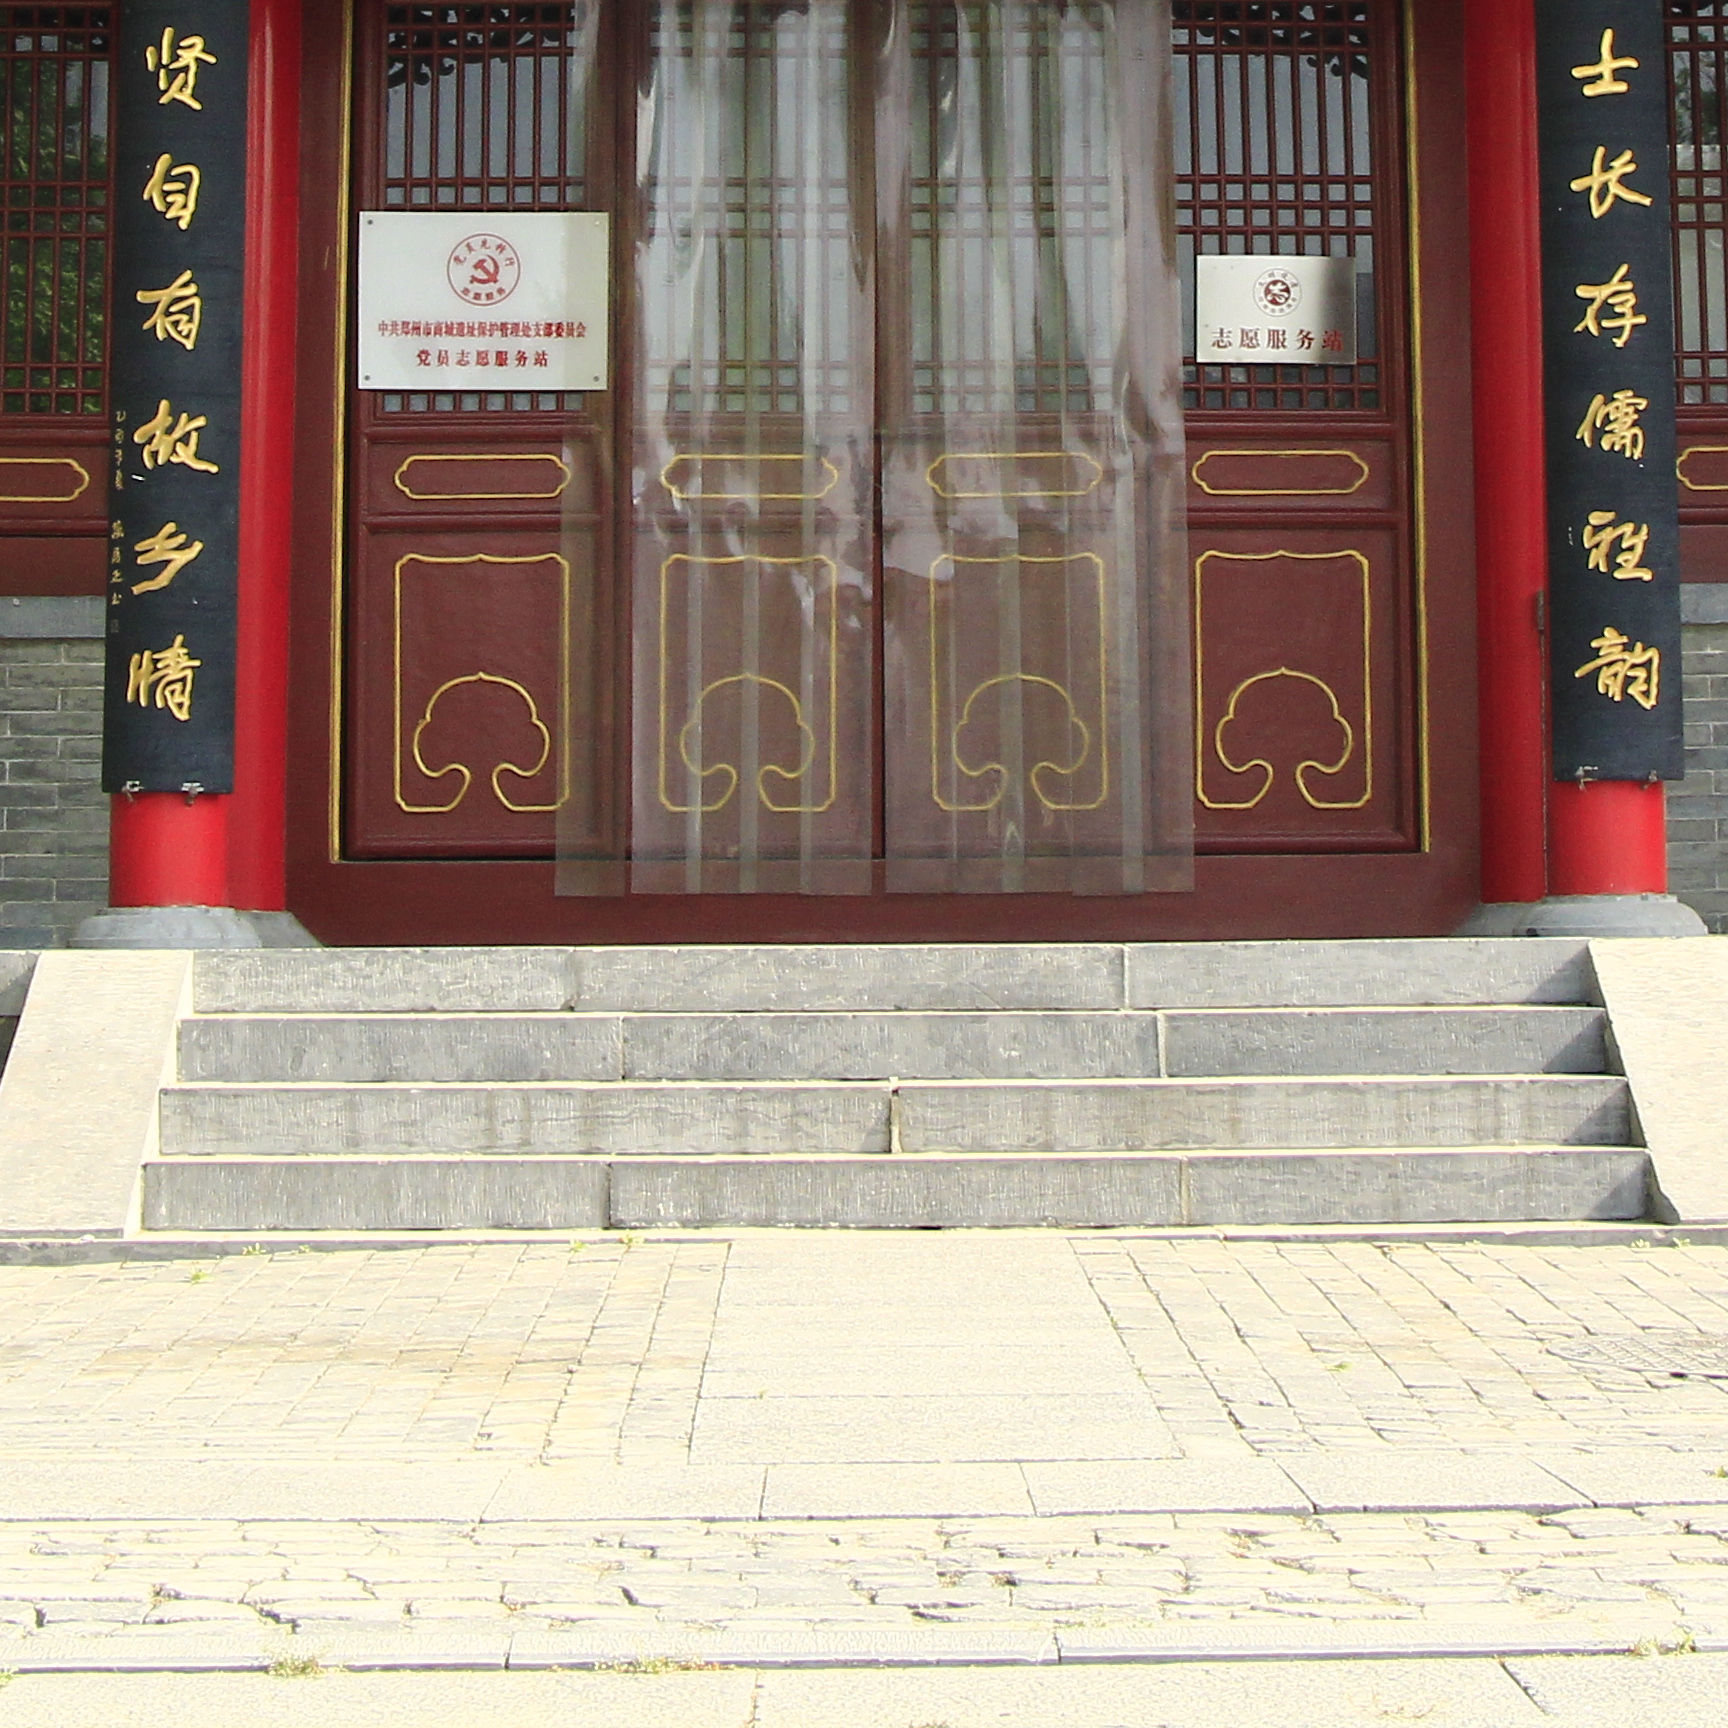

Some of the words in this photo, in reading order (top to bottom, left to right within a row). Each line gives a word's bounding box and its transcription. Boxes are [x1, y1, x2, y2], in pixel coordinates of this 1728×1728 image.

[1211, 328, 1344, 353] 志愿服务站
[416, 349, 549, 368] 党员志愿服务站
